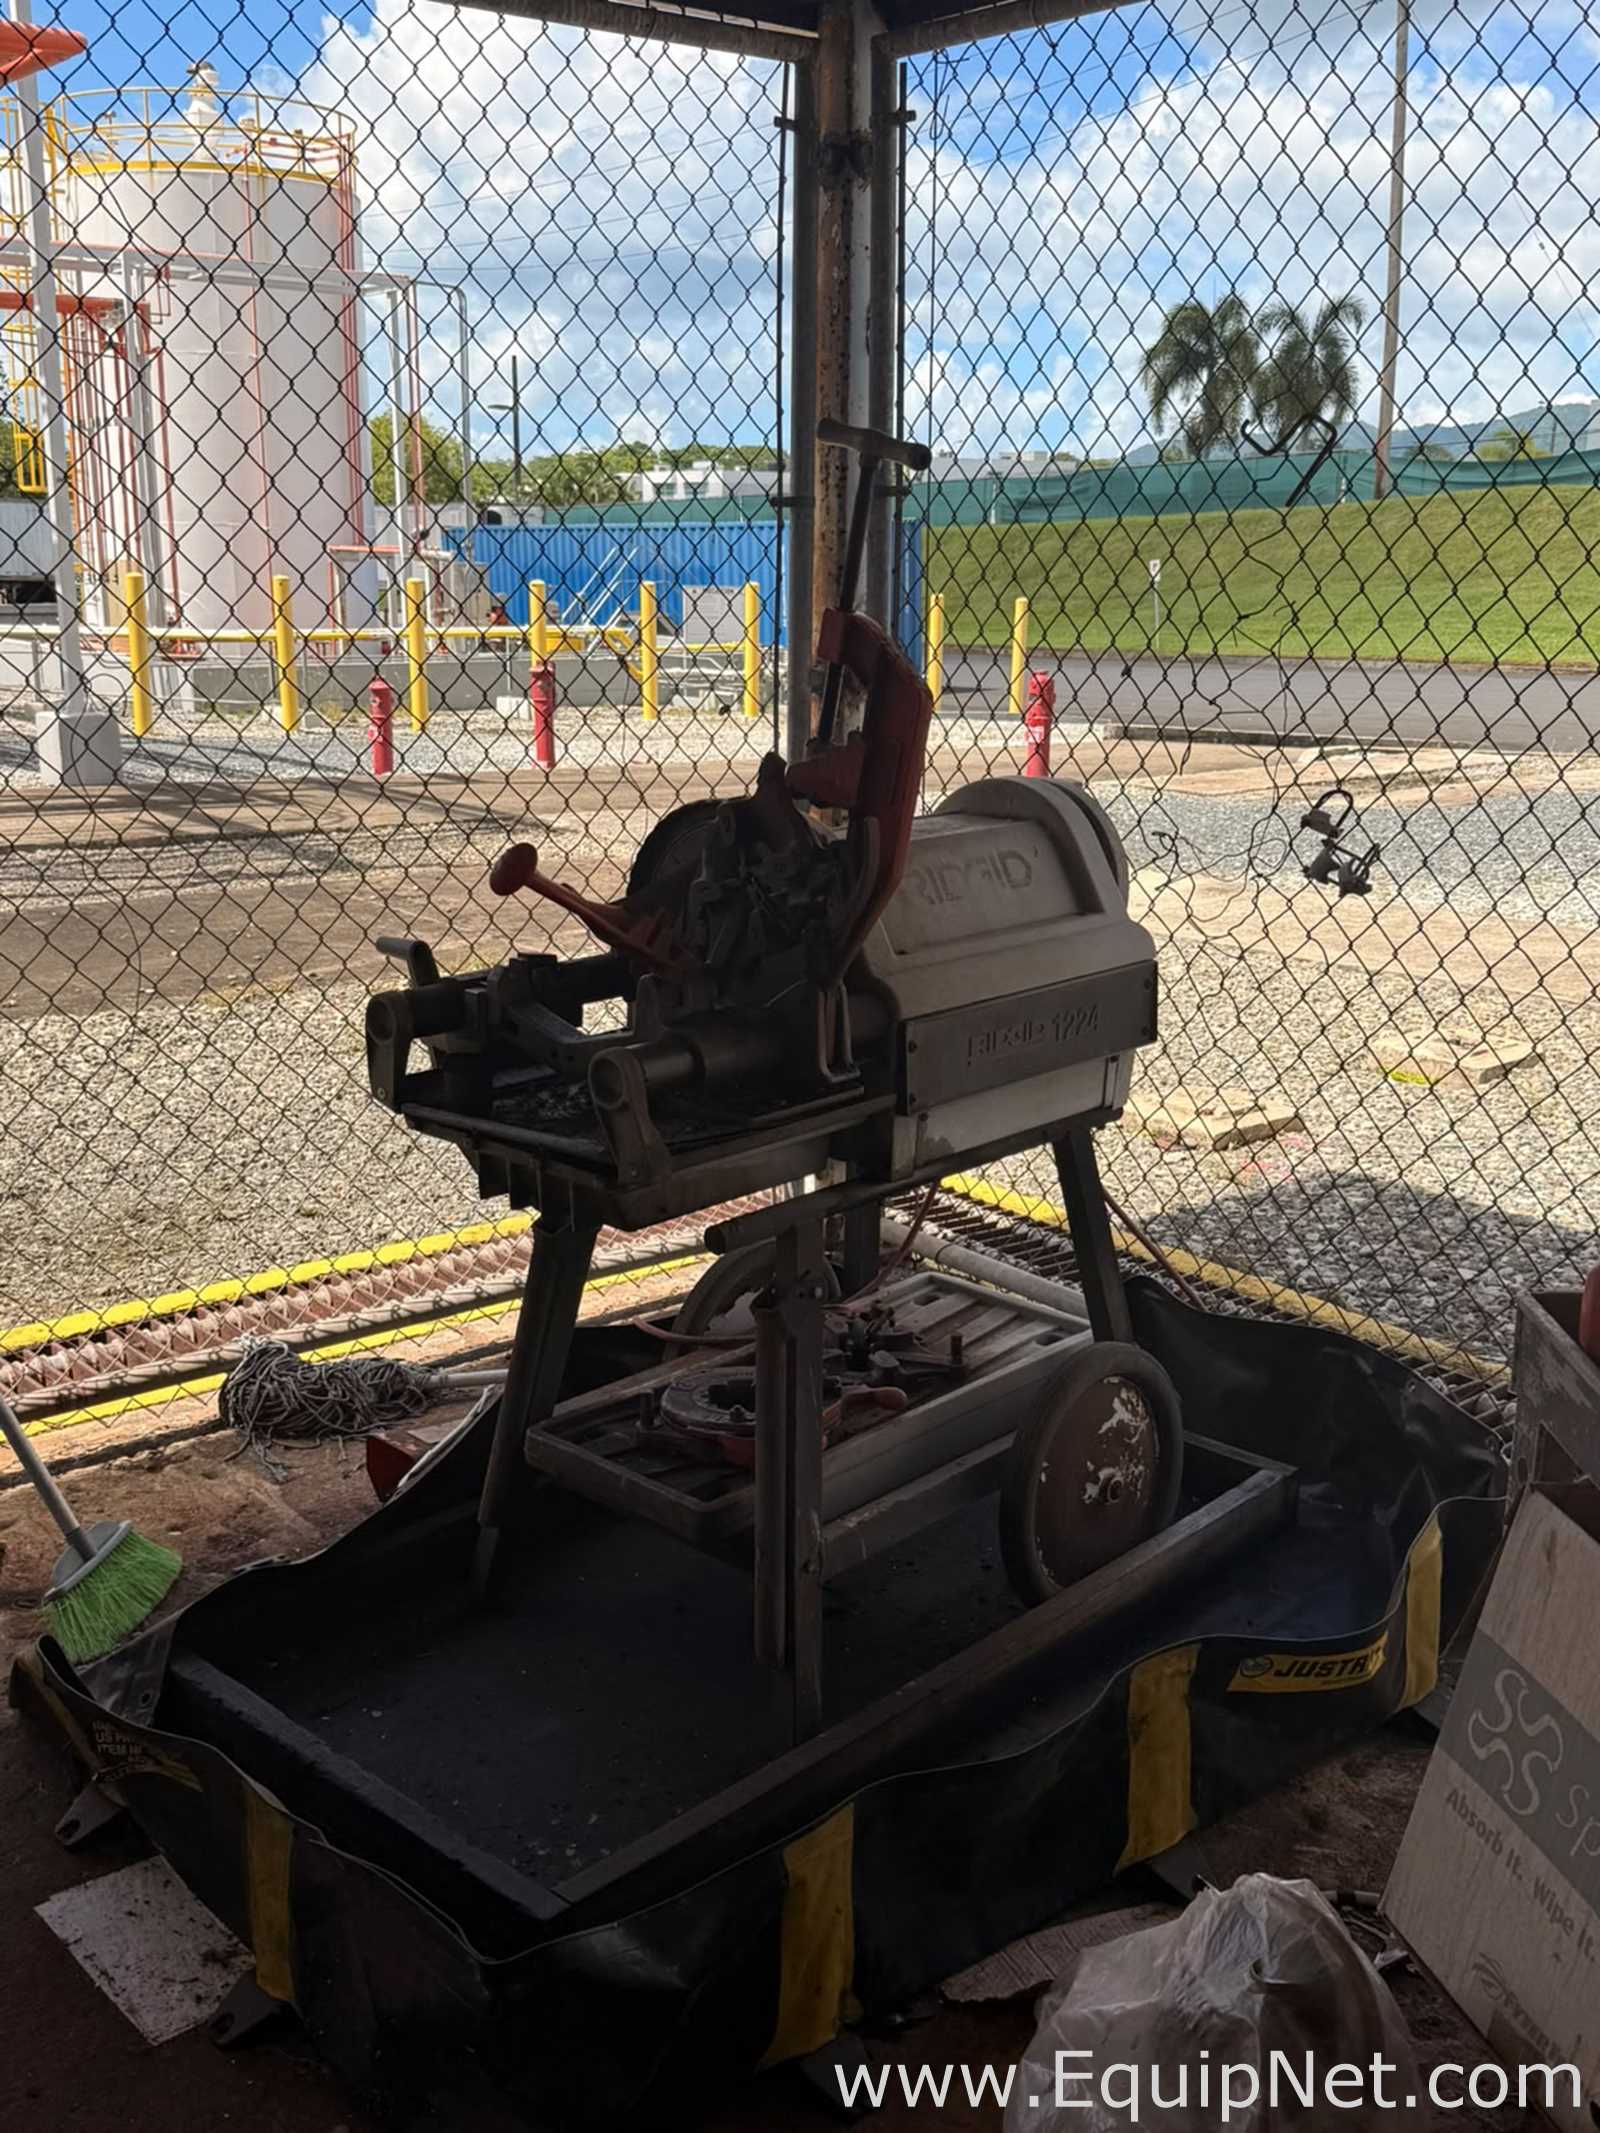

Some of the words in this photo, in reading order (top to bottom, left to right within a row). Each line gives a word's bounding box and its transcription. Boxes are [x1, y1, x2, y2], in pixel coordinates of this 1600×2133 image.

[1051, 1003, 1099, 1042] 1224
[1445, 1787, 1502, 1854] Absorb
[1504, 1848, 1523, 1881] It.
[1532, 1876, 1575, 1937] Wipe
[1577, 1926, 1596, 1963] It.
